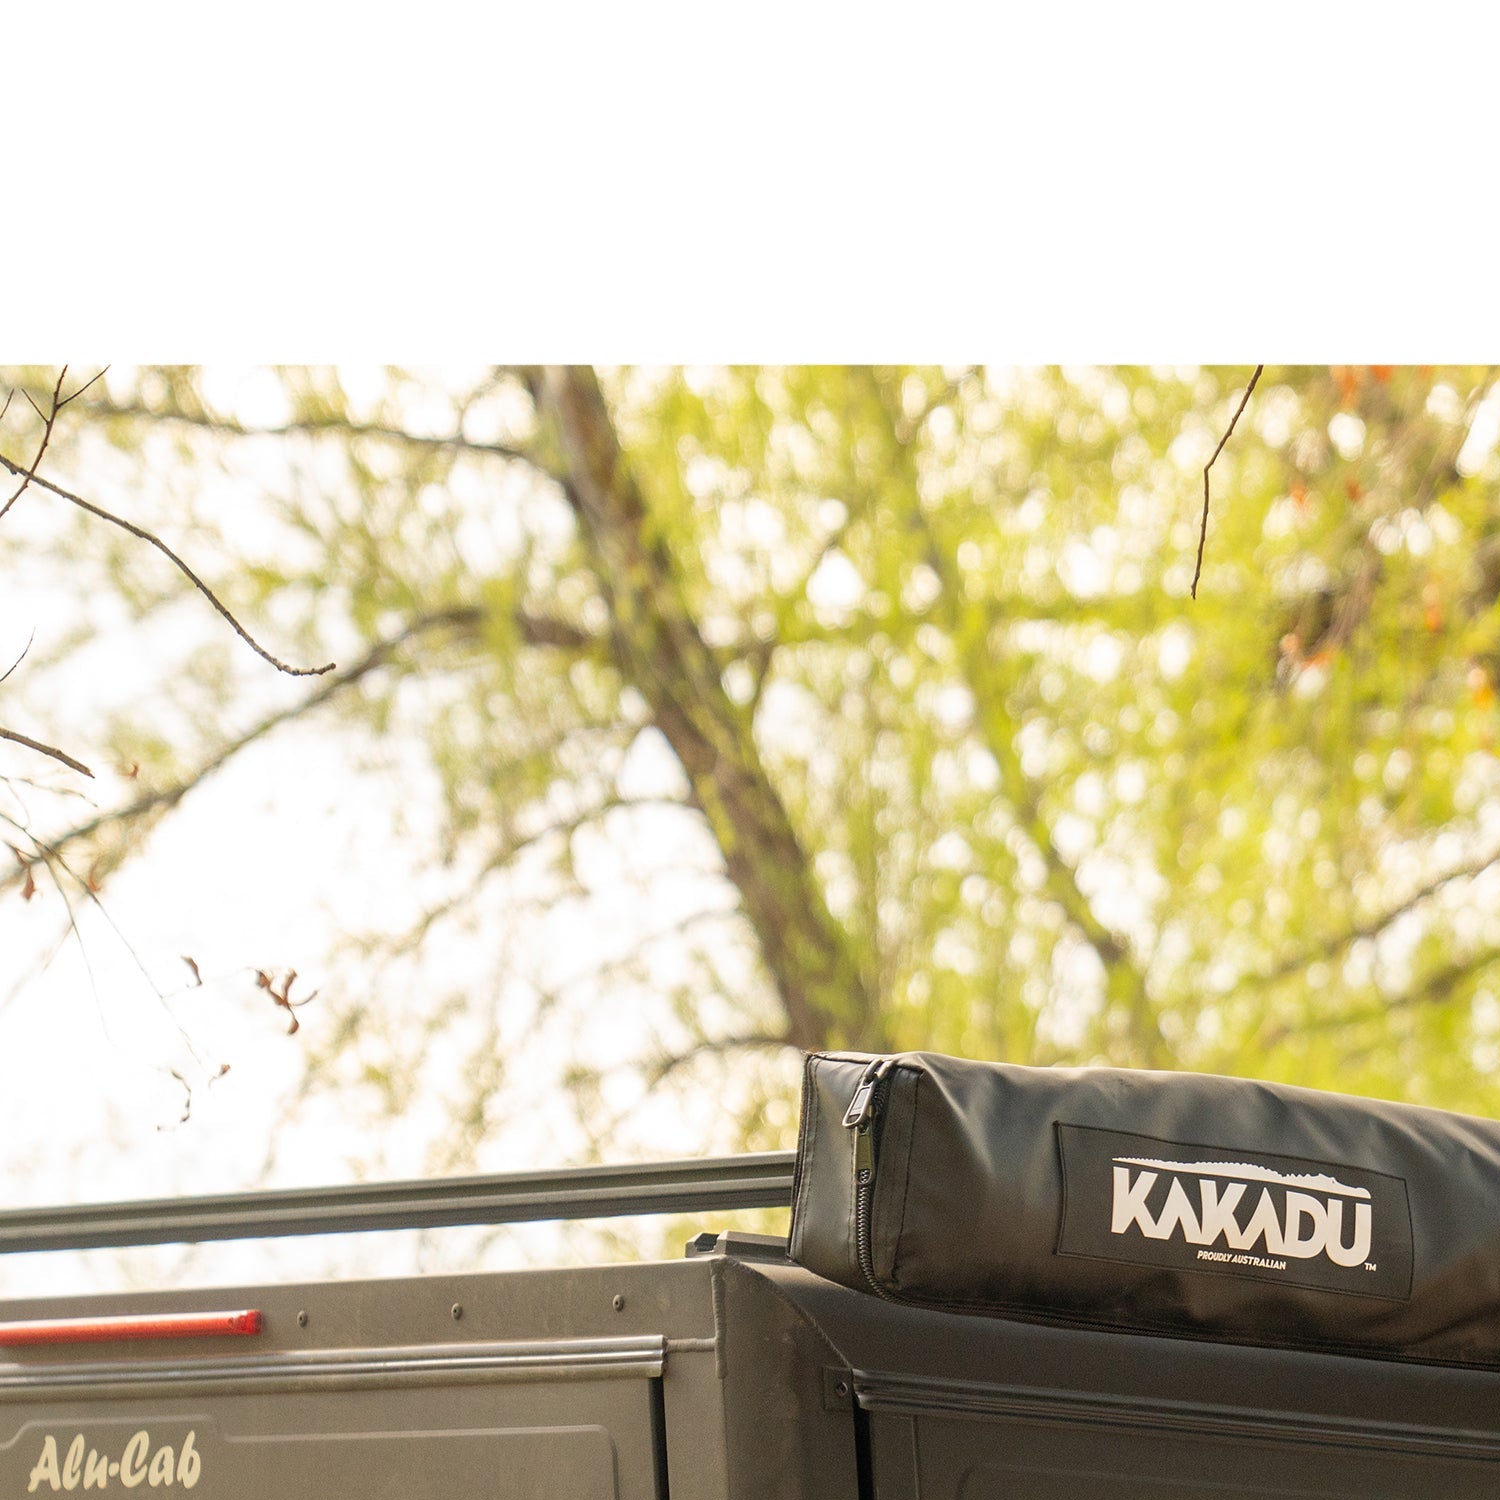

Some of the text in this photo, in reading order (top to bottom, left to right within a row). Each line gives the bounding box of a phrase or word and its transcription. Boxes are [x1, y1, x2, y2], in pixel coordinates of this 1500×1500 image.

[1111, 1166, 1372, 1267] KAKADU
[1197, 1250, 1287, 1270] PROUDLY AUSTRALIAN
[27, 1430, 201, 1493] Alu-Cab
